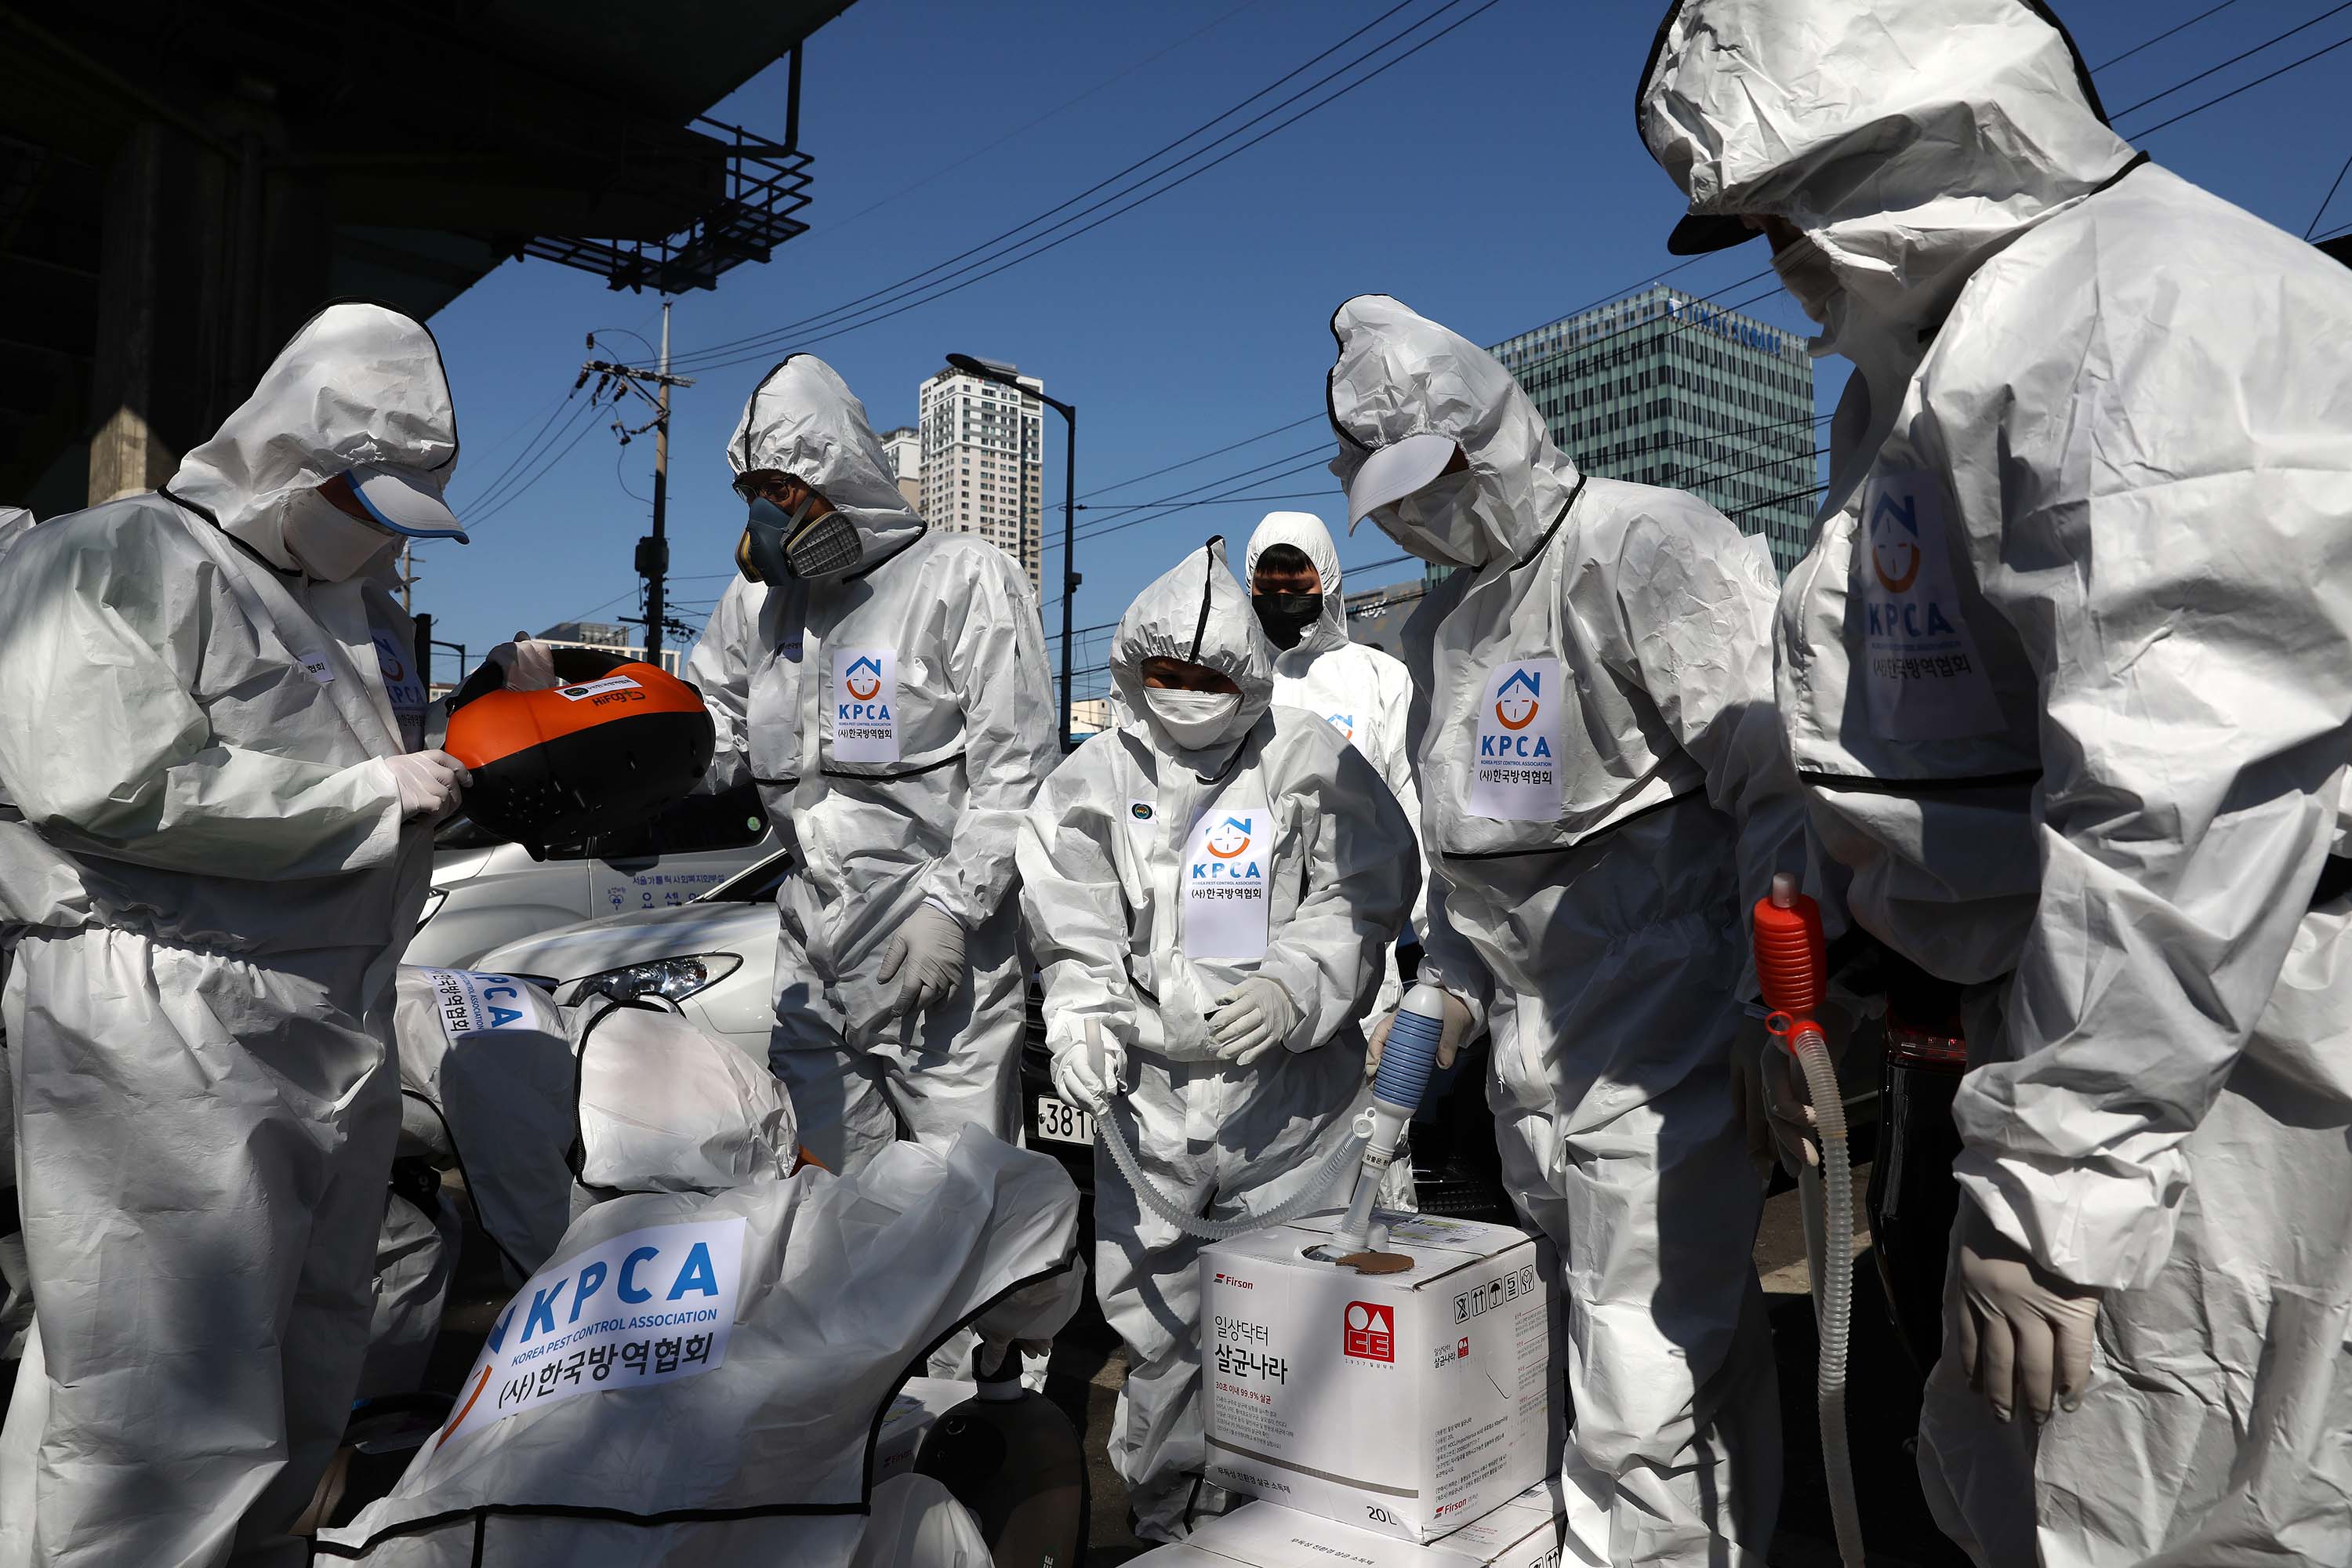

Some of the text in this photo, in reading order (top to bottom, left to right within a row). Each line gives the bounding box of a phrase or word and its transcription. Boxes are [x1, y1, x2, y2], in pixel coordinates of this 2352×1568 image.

[1869, 603, 1956, 637] KPCA
[839, 705, 891, 720] KPCA
[838, 728, 892, 739] (사)한국방역협회
[1481, 735, 1552, 757] KPCA
[1479, 768, 1552, 785] (사)한국방역협회
[1192, 862, 1261, 879] KPCA
[1192, 887, 1261, 900] (사)한국방역협회
[471, 972, 523, 1029] PCA
[519, 1242, 719, 1344] KPCA
[1225, 1276, 1254, 1290] Firson
[511, 1308, 717, 1367] KOREA PEST CONTROL ASSOCIATION
[1215, 1316, 1268, 1346] 일상닥터
[1434, 1344, 1451, 1356] 일상닥터
[1434, 1352, 1456, 1369] 살균나라
[499, 1332, 714, 1409] (사)한국방역협회
[1215, 1343, 1288, 1385] 살균나라
[1216, 1381, 1271, 1404] 30초 이내 99.9% 살균
[1218, 1467, 1291, 1494] 무독성 친환경 살균 소독제
[1367, 1505, 1398, 1526] 20L
[1445, 1498, 1467, 1515] Firson
